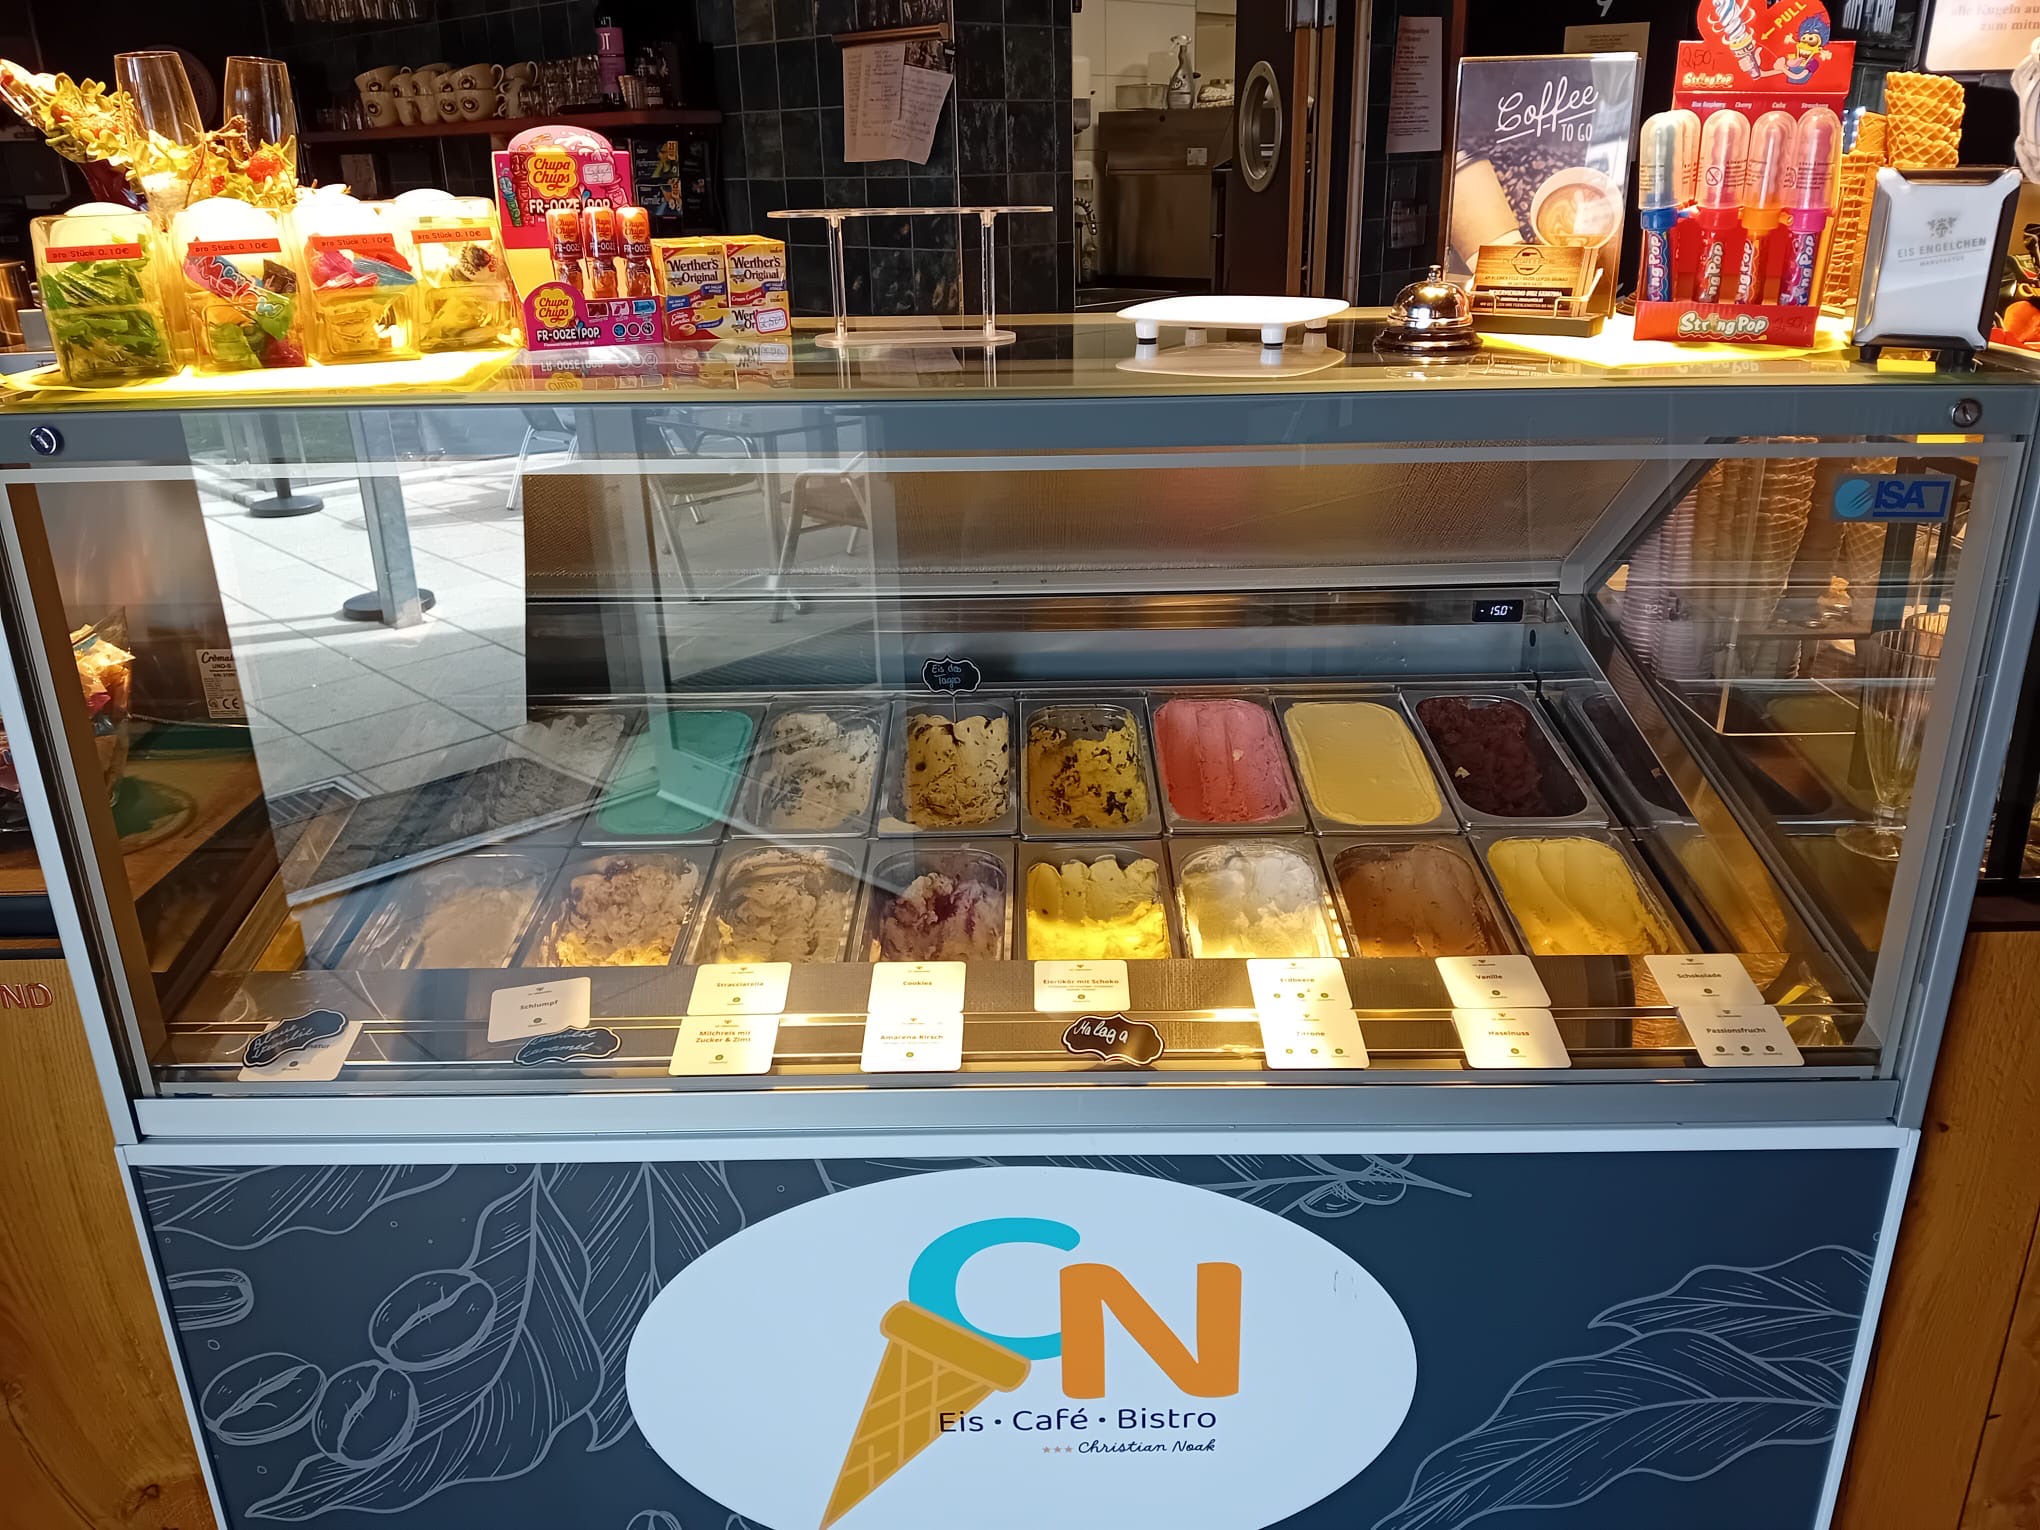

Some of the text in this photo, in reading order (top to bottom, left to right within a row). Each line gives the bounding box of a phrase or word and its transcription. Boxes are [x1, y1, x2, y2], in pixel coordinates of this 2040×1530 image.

[1774, 2, 1807, 29] PULL
[1495, 76, 1599, 137] Coffee
[1561, 123, 1593, 142] TO GO
[534, 158, 571, 172] Chupa
[533, 170, 571, 188] Chups
[1897, 237, 1986, 258] EIS ENGELCHEN
[667, 258, 719, 272] Werther's
[731, 256, 780, 269] Werther's
[682, 271, 718, 284] Original
[744, 269, 779, 281] Original
[539, 298, 569, 308] Chupa
[539, 307, 569, 319] Chups
[536, 327, 600, 341] FR-OOZE POP
[1874, 481, 1925, 509] ISA
[932, 664, 945, 673] Eis
[520, 1000, 559, 1010] Schlumpf
[908, 1217, 1242, 1400] CN
[939, 1408, 1217, 1433] Eis Café Bistro
[1078, 1439, 1216, 1454] Christian Noak
